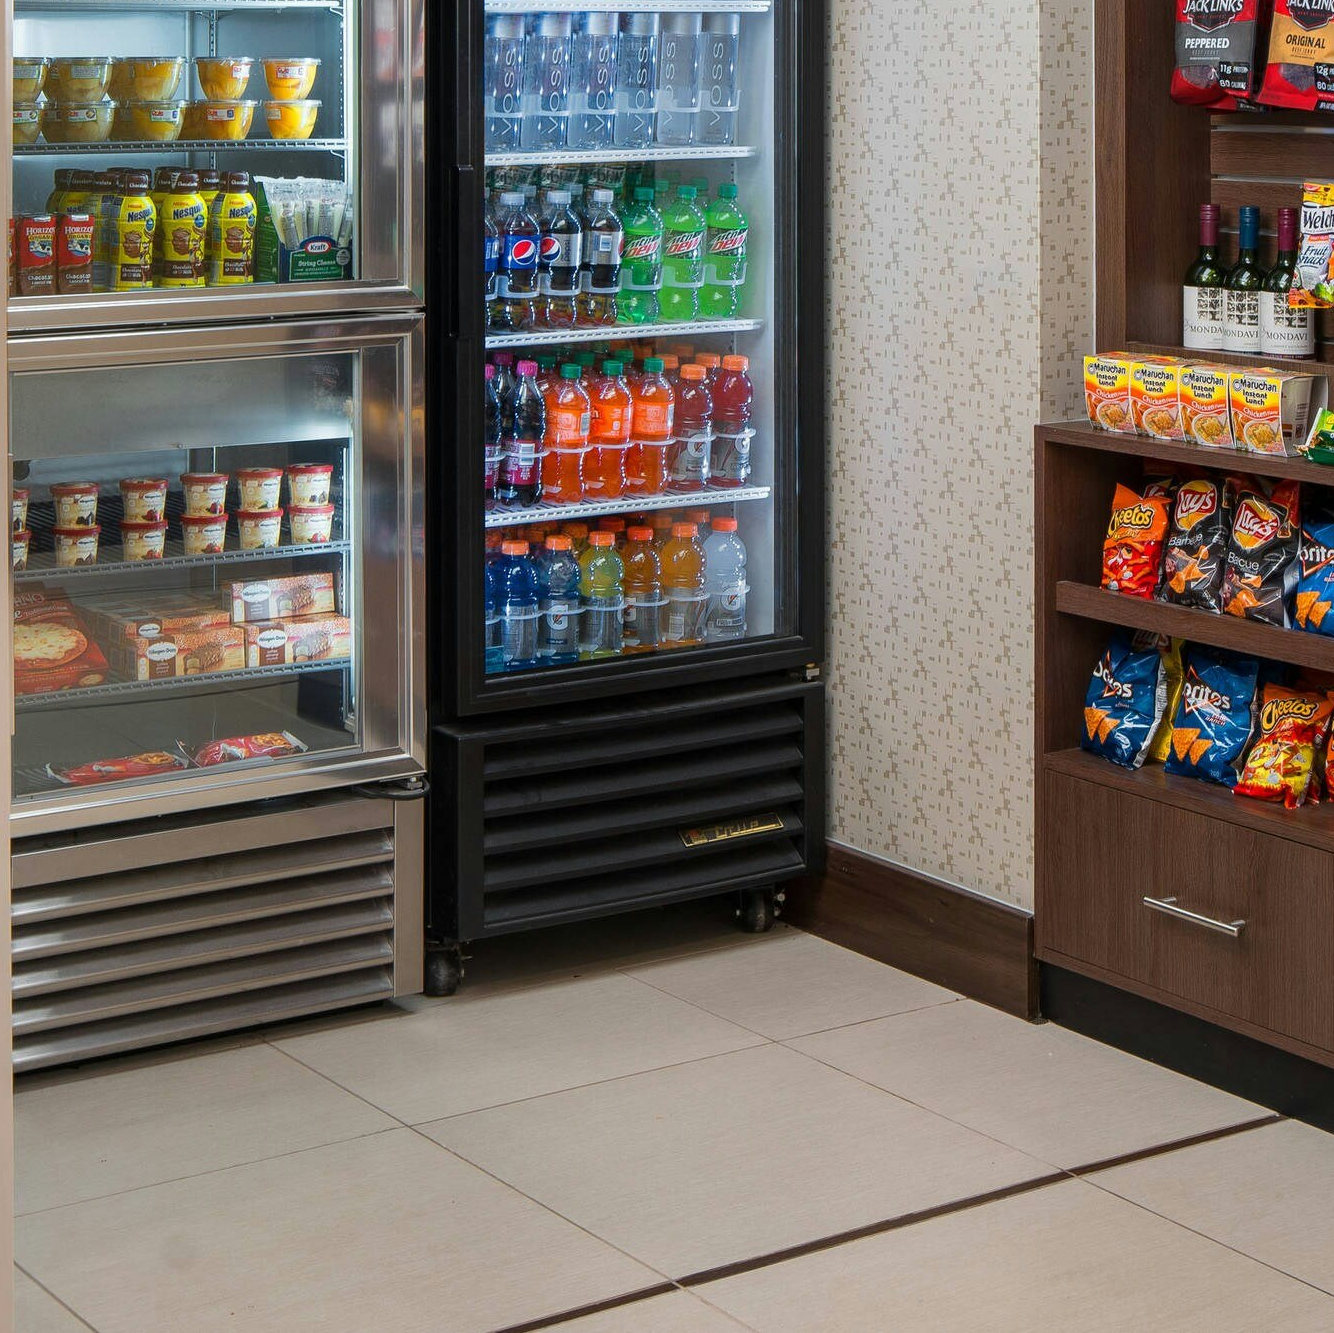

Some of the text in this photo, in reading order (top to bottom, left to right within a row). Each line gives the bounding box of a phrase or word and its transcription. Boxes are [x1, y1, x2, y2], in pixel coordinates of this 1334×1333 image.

[1184, 37, 1230, 49] PEPPERED
[1285, 33, 1326, 50] ORIGINAL
[1219, 64, 1232, 75] 11g
[593, 44, 610, 133] VOSS
[633, 45, 649, 132] VOSS
[709, 41, 724, 126] VOSS
[1219, 79, 1230, 88] 80
[500, 48, 517, 136] VOSS
[547, 45, 563, 134] VOSS
[309, 243, 326, 252] Kraft
[1304, 245, 1328, 256] Fruit
[1190, 325, 1223, 334] MONDA
[1266, 331, 1308, 341] MONDAVI
[1094, 362, 1126, 375] Maruchan
[1096, 371, 1118, 382] Instant
[1141, 368, 1174, 381] Maruchan
[1188, 373, 1224, 386] Maruchan
[1098, 379, 1116, 388] Lunch
[1142, 377, 1166, 388] Instant
[1190, 382, 1215, 394] Instant
[1240, 378, 1277, 393] Maruchan
[1095, 388, 1116, 399] Chicken
[1145, 385, 1164, 394] Lunch
[1193, 390, 1213, 400] Lunch
[1242, 388, 1267, 401] Instant
[1142, 394, 1166, 405] Chicken
[1245, 397, 1265, 407] Lunch
[1191, 400, 1215, 411] Chicken
[1243, 407, 1267, 418] Chicken
[1261, 699, 1318, 732] Cheetos
